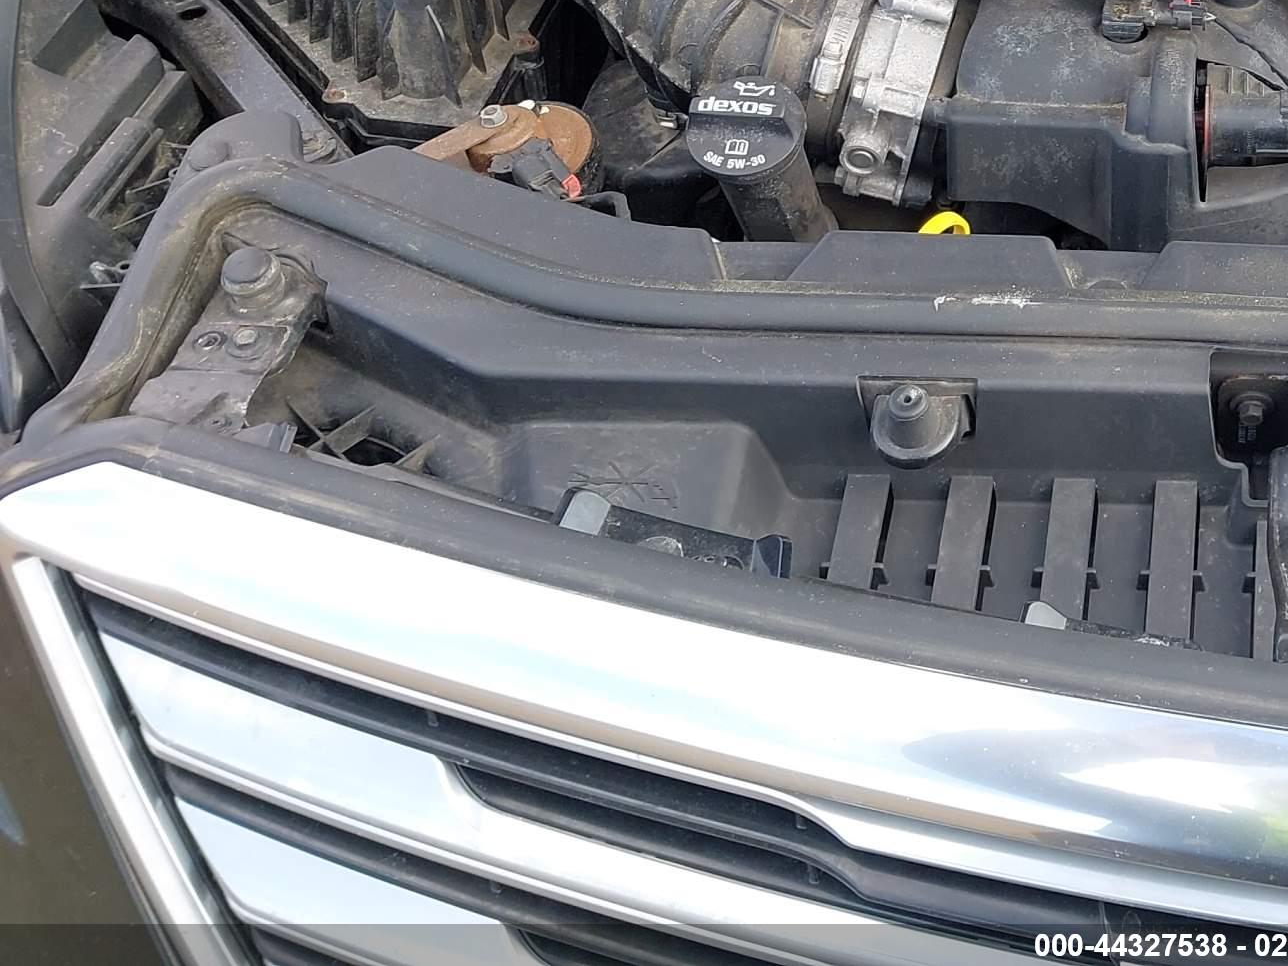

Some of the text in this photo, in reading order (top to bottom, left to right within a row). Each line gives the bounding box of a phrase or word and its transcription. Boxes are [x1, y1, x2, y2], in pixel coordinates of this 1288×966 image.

[697, 96, 777, 116] dexos
[703, 151, 767, 170] SAE 5W-30
